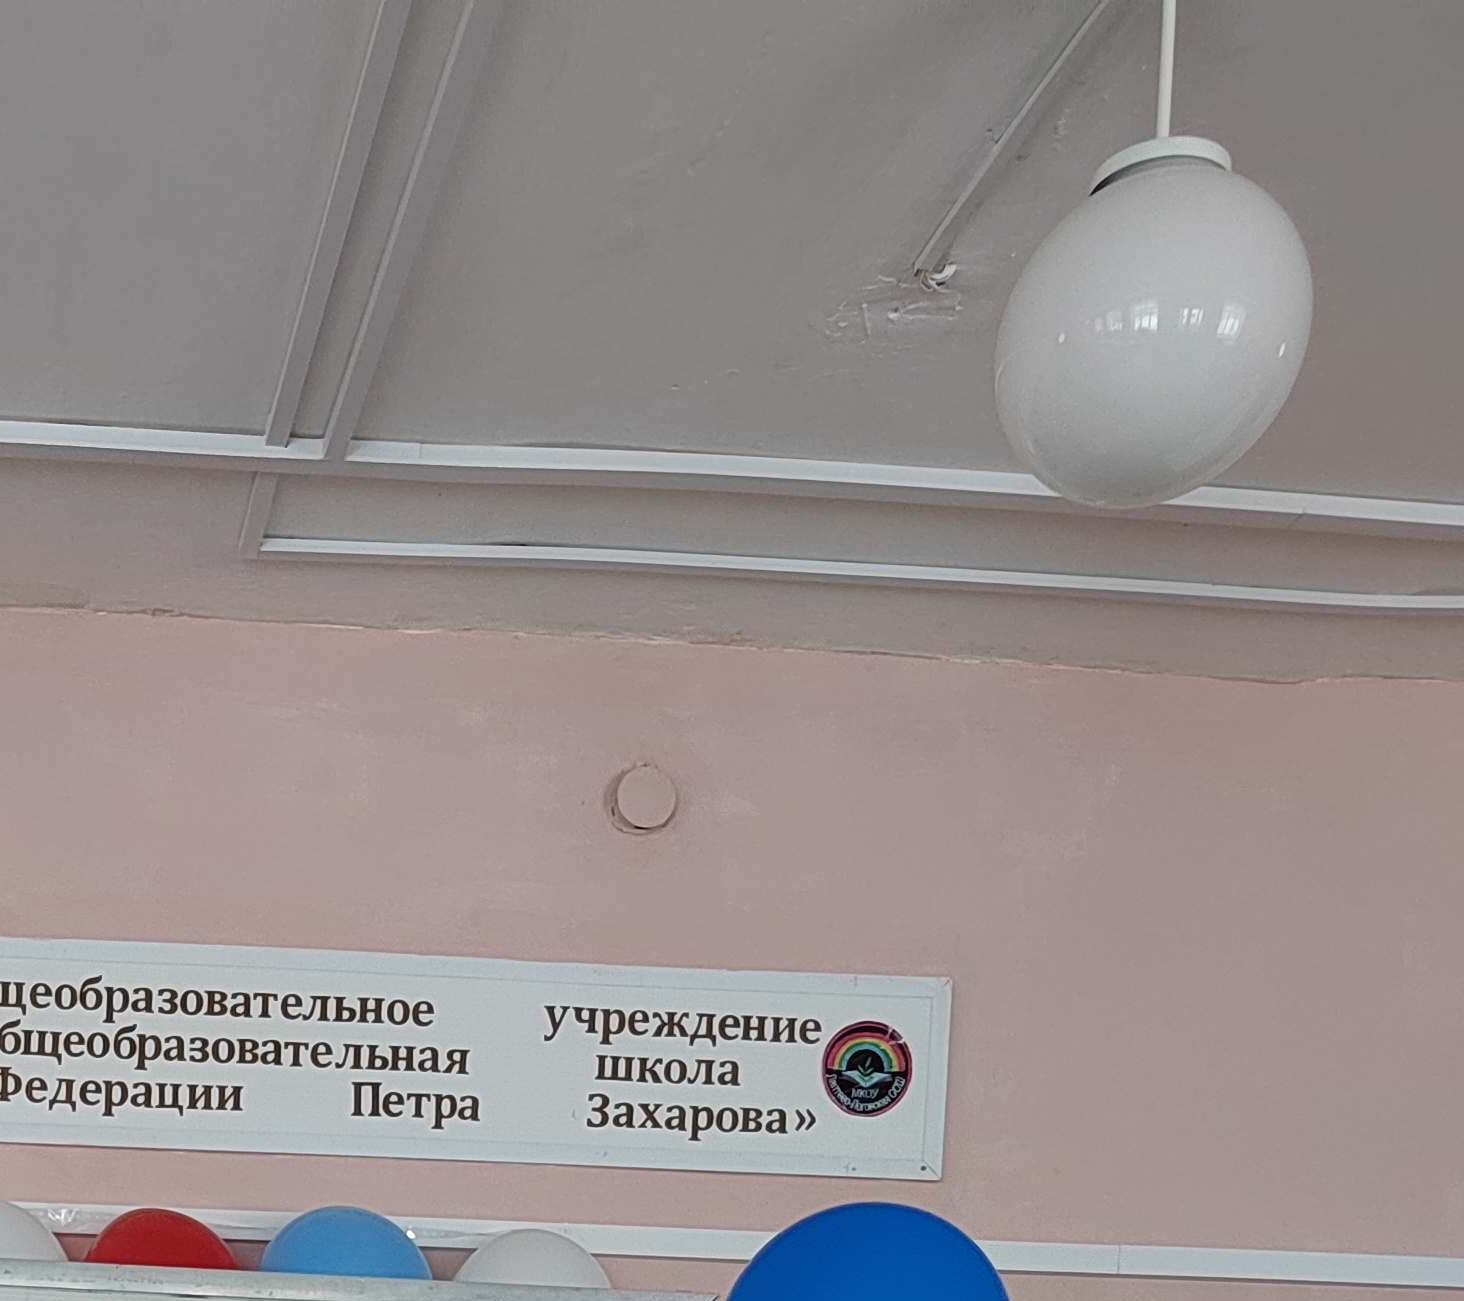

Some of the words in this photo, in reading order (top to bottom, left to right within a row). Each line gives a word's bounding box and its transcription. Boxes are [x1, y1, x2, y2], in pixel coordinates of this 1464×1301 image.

[541, 1000, 822, 1045] учреждение
[594, 1051, 741, 1087] школа
[350, 1081, 481, 1129] Петра
[585, 1092, 818, 1141] Захарова»
